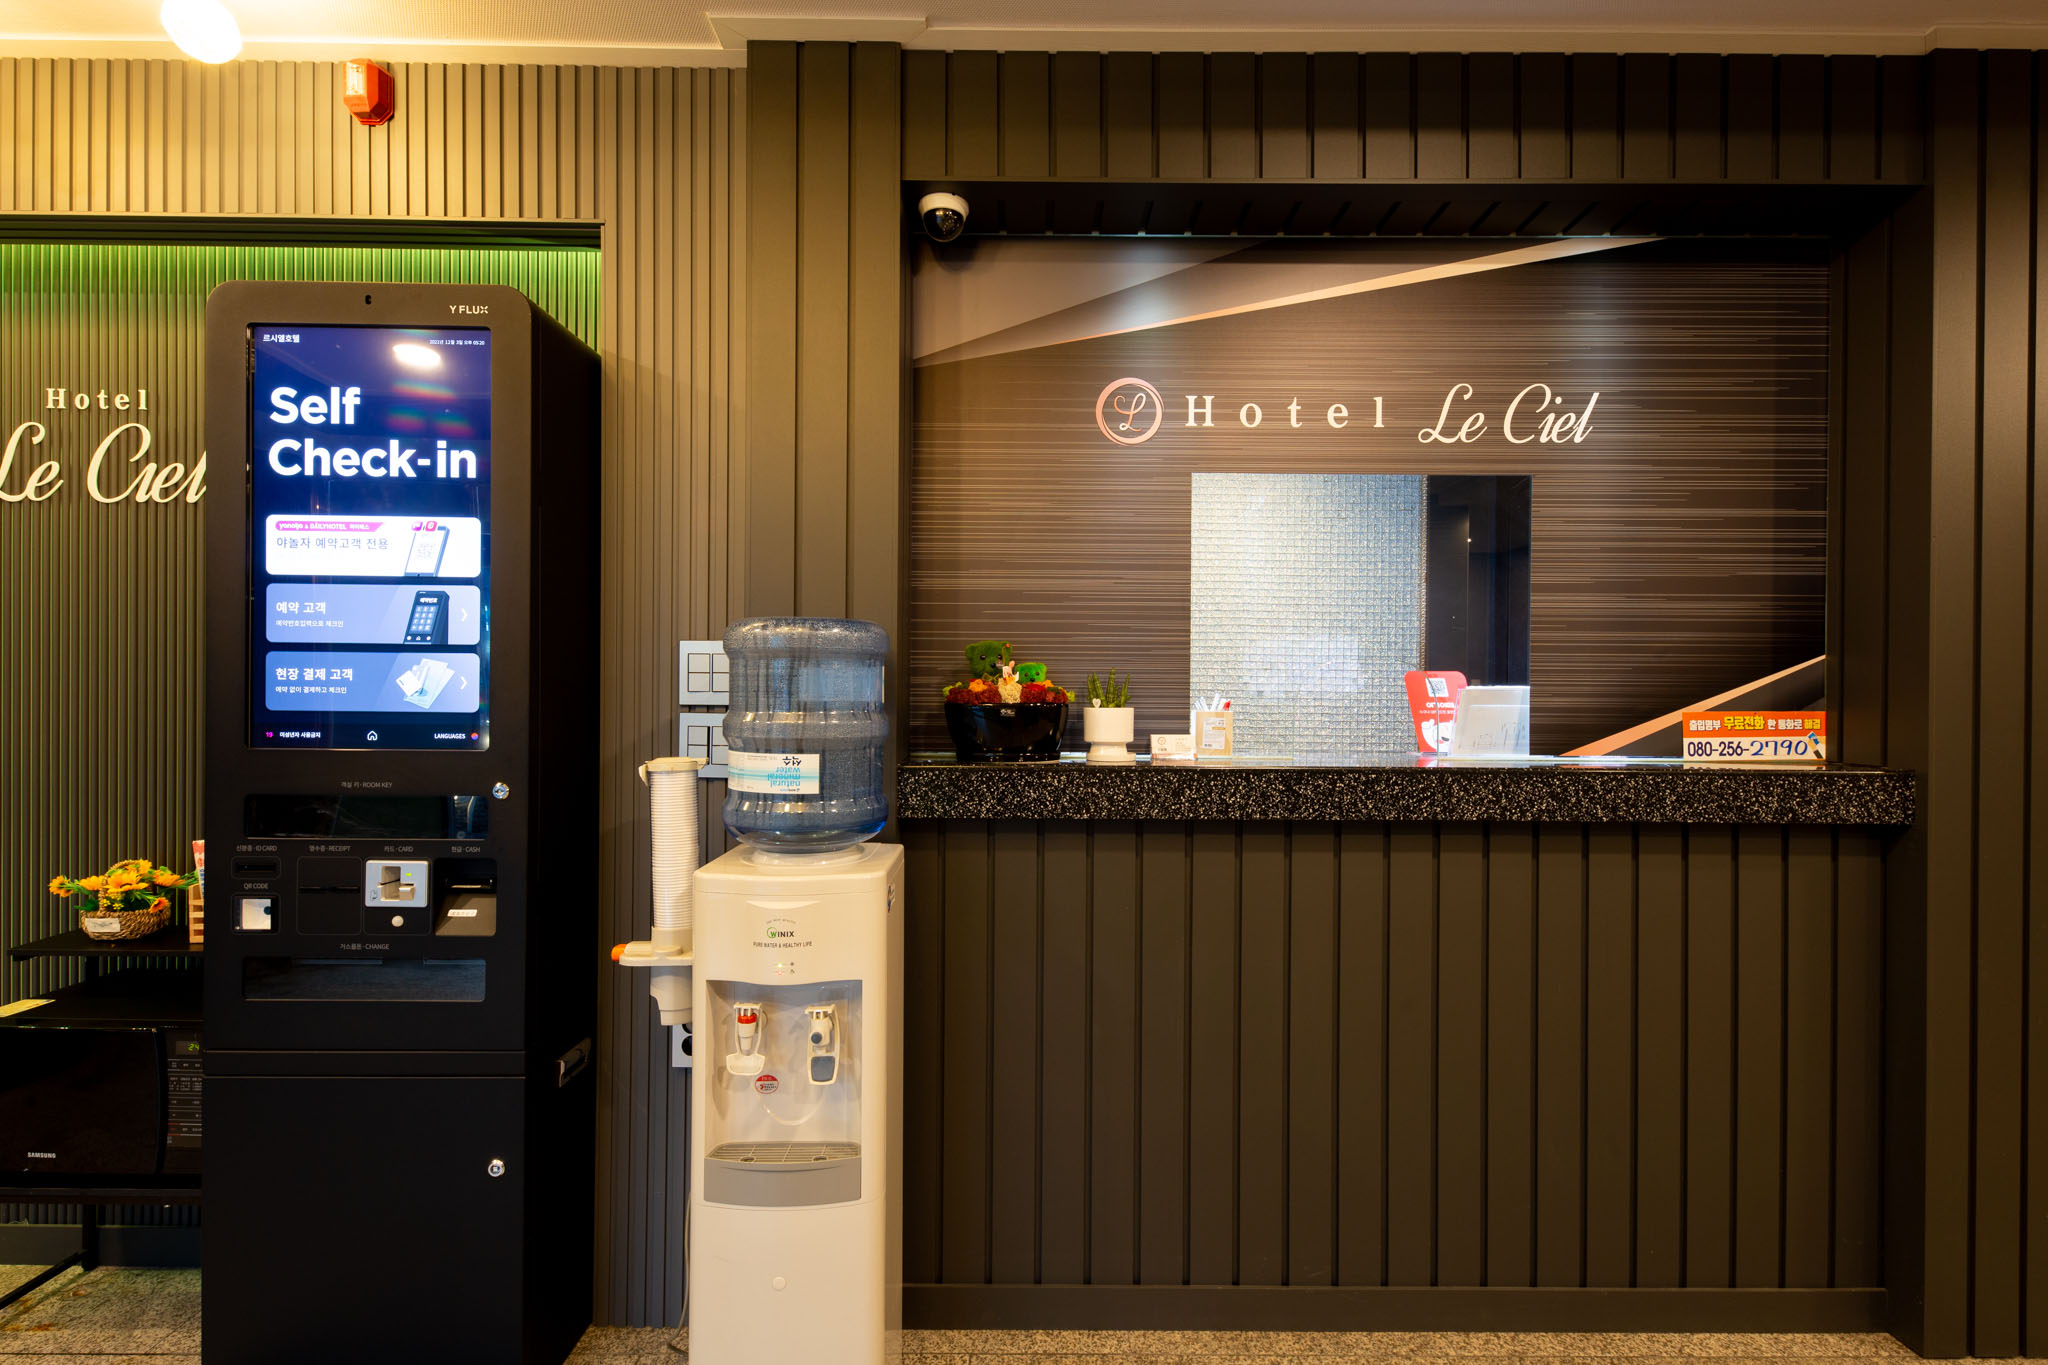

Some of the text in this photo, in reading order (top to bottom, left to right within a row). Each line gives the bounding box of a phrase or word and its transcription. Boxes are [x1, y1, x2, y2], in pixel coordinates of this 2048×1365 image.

[459, 305, 489, 315] FLUX
[262, 334, 300, 343] 르시엘호텔
[46, 388, 148, 411] Hotel
[269, 386, 361, 425] Self
[1185, 383, 1600, 444] Hotel Le Ciel
[0, 421, 64, 503] Le
[268, 438, 477, 479] Check-in
[276, 536, 389, 550] 야놀자 예약고객 전용
[276, 601, 326, 615] 예약 고객
[275, 667, 353, 682] 현장 결제 고객
[328, 686, 347, 694] 체크인
[1689, 716, 1821, 731] 출입명부 무료전화 한 통화로 해결
[1688, 740, 1808, 757] 080-256-2790
[782, 756, 802, 767] 석수
[776, 766, 800, 774] water
[768, 773, 800, 782] mineral
[770, 780, 800, 788] natural
[769, 930, 795, 938] WINIX
[27, 1151, 57, 1159] SAMSUNG
